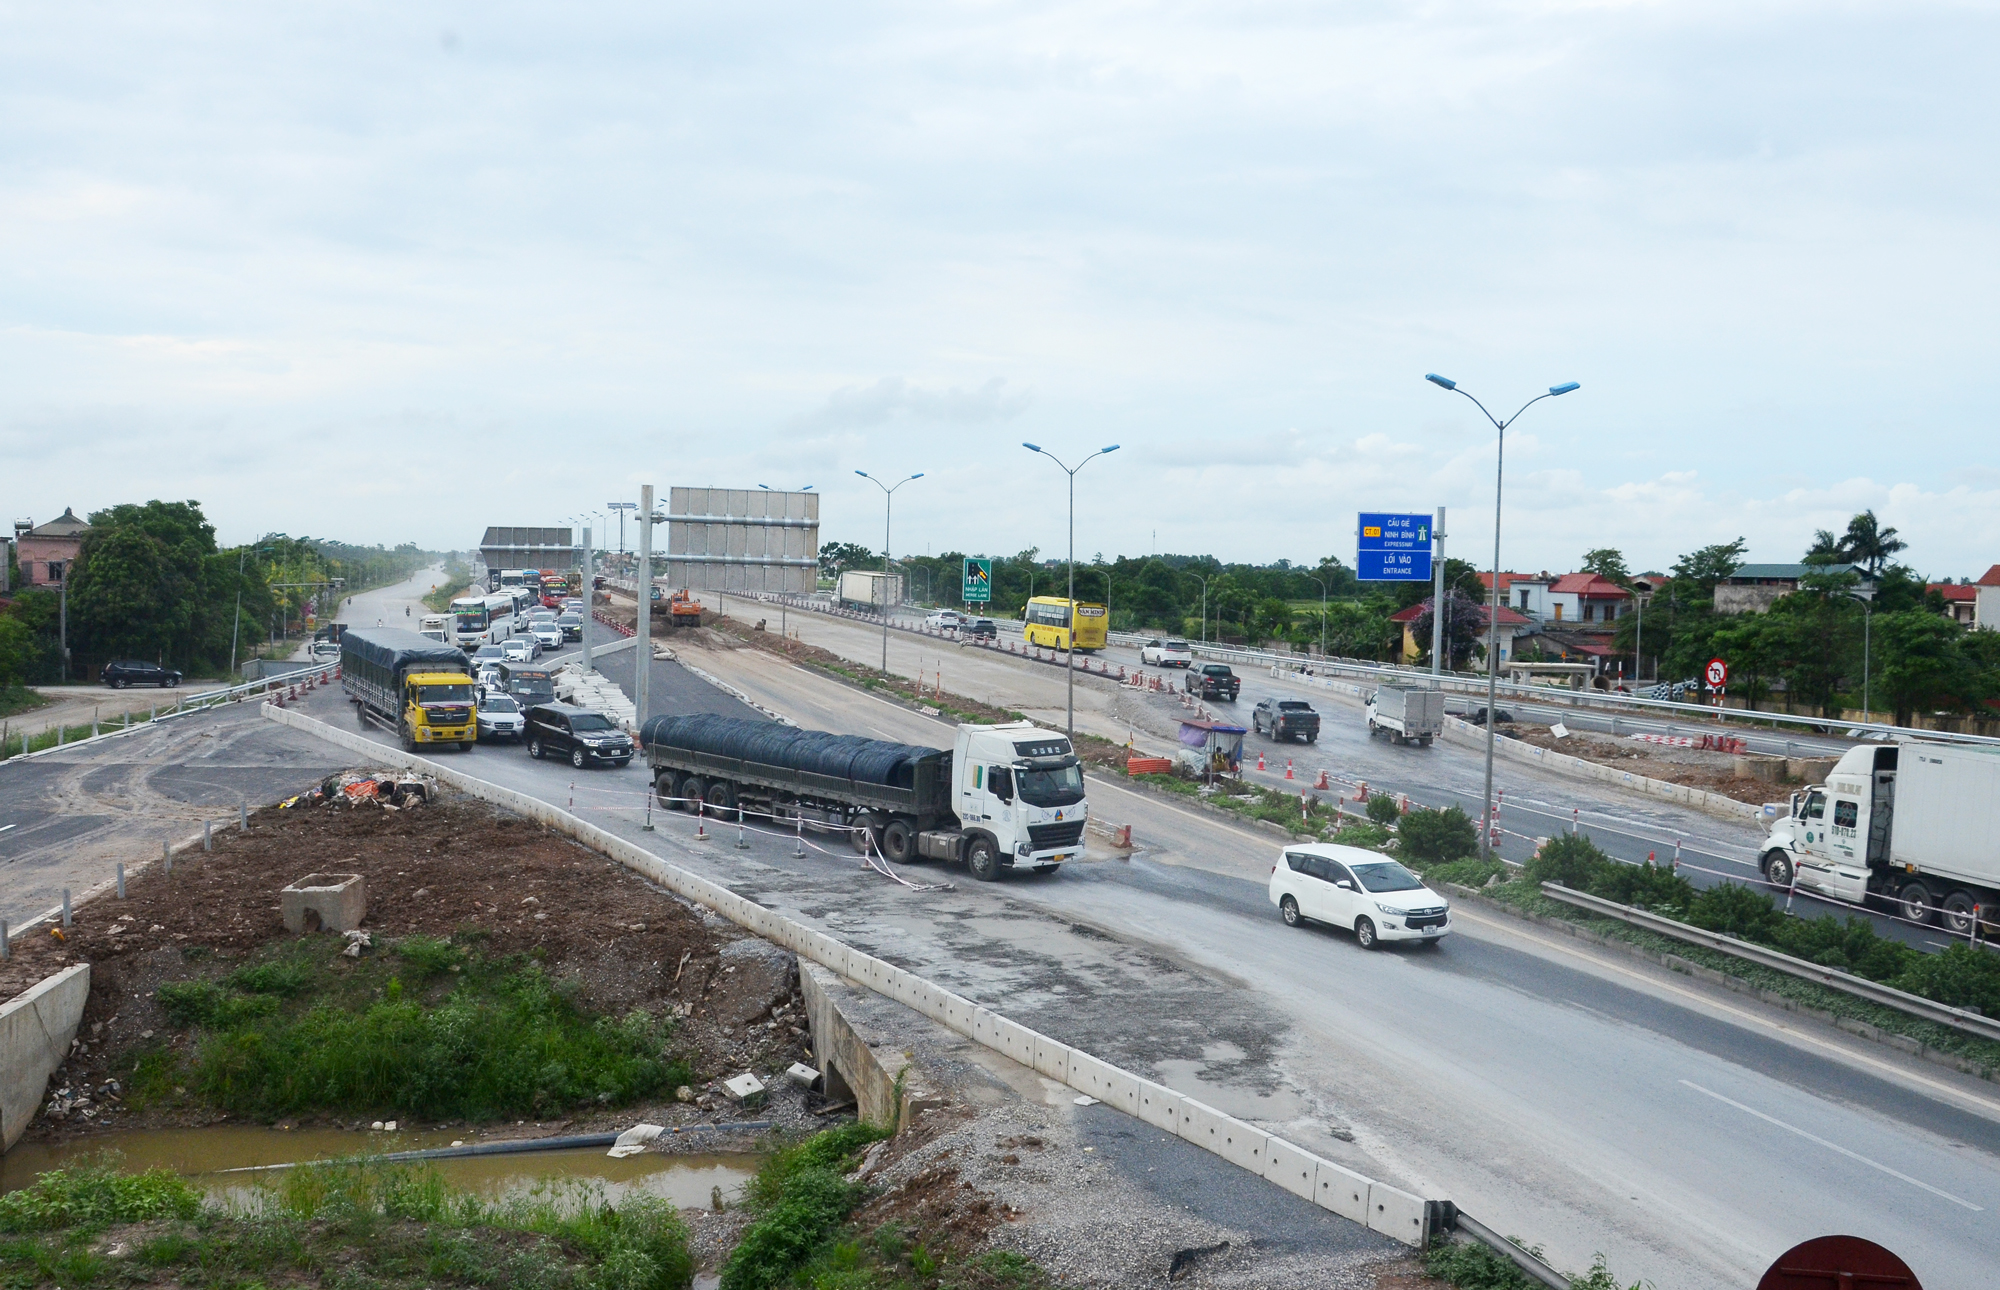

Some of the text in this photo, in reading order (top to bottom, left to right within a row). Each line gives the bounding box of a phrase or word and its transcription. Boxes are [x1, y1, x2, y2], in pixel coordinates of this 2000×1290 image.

[1401, 530, 1414, 539] BÌNH
[1384, 552, 1412, 564] LỐI VÀO
[1383, 567, 1412, 575] ENTRANCE
